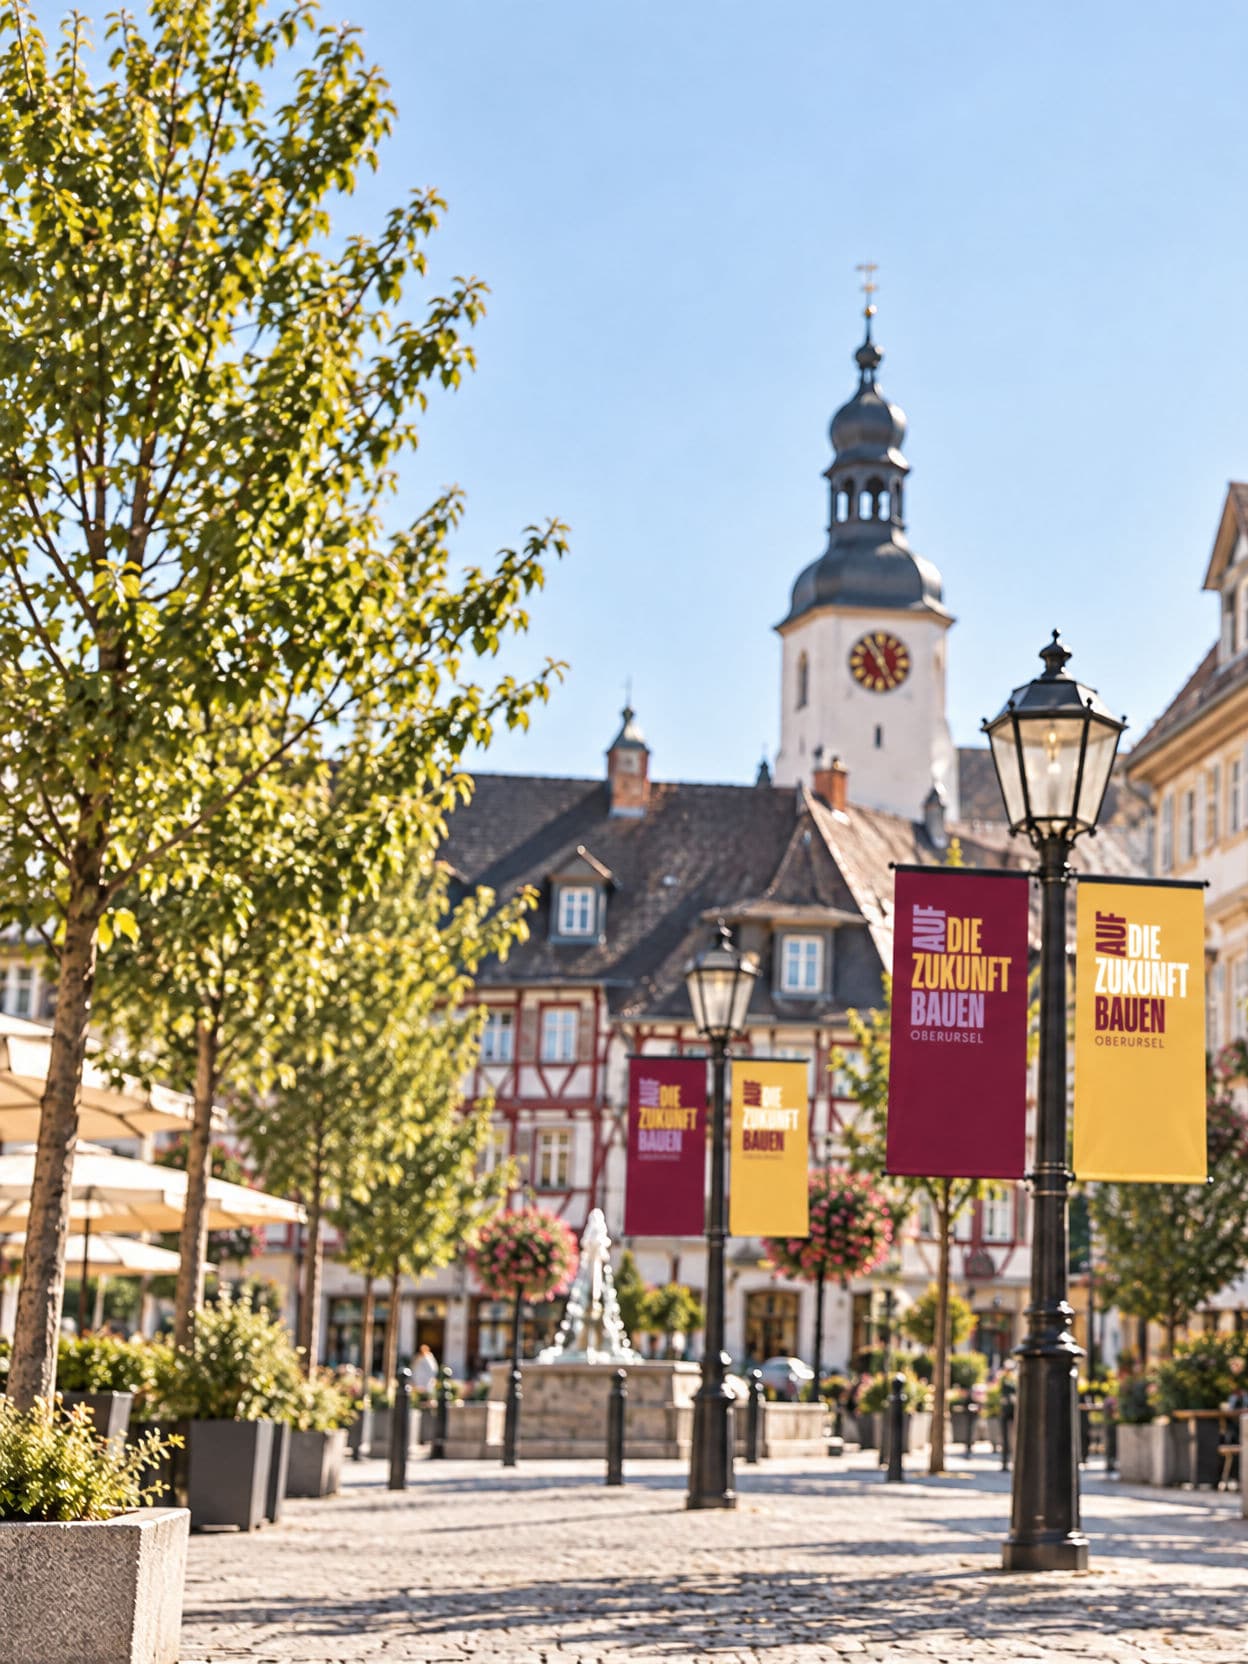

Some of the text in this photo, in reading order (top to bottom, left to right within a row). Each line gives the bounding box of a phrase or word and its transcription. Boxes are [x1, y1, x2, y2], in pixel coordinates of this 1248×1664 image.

[912, 904, 946, 952] AUF
[947, 917, 983, 954] DIE
[1095, 911, 1127, 957] AUF
[1128, 924, 1161, 959] DIE
[911, 953, 1012, 992] ZUKUNFT
[1094, 958, 1190, 998] ZUKUNFT
[911, 991, 984, 1028] BAUEN
[1095, 996, 1165, 1033] BAUEN
[910, 1031, 984, 1044] OBERURSEL
[1094, 1036, 1165, 1049] OBERURSEL
[638, 1107, 698, 1131] ZUKUNFT
[638, 1130, 682, 1152] BAUEN
[743, 1130, 785, 1151] BAUEN
